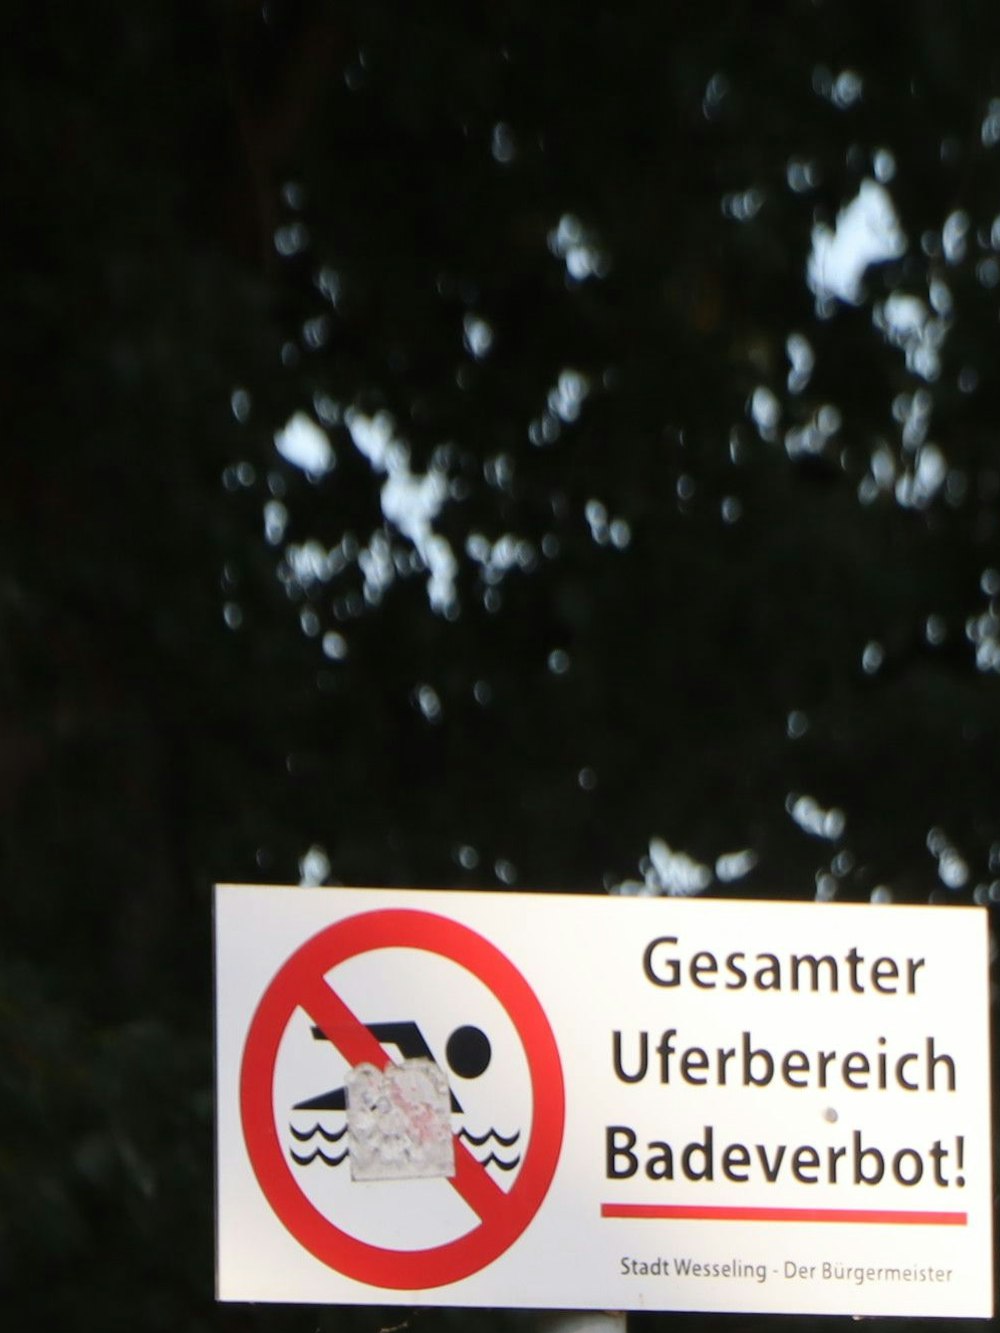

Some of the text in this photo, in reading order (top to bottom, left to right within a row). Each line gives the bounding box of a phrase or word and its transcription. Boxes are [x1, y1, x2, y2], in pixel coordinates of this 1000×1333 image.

[641, 935, 926, 995] Gesamter
[611, 1028, 958, 1092] Uferbereich
[604, 1124, 967, 1189] Badeverbot!
[619, 1256, 671, 1277] Stadt
[673, 1258, 768, 1284] Wesseling
[783, 1260, 817, 1280] Der
[821, 1261, 953, 1286] Bürgermeister
